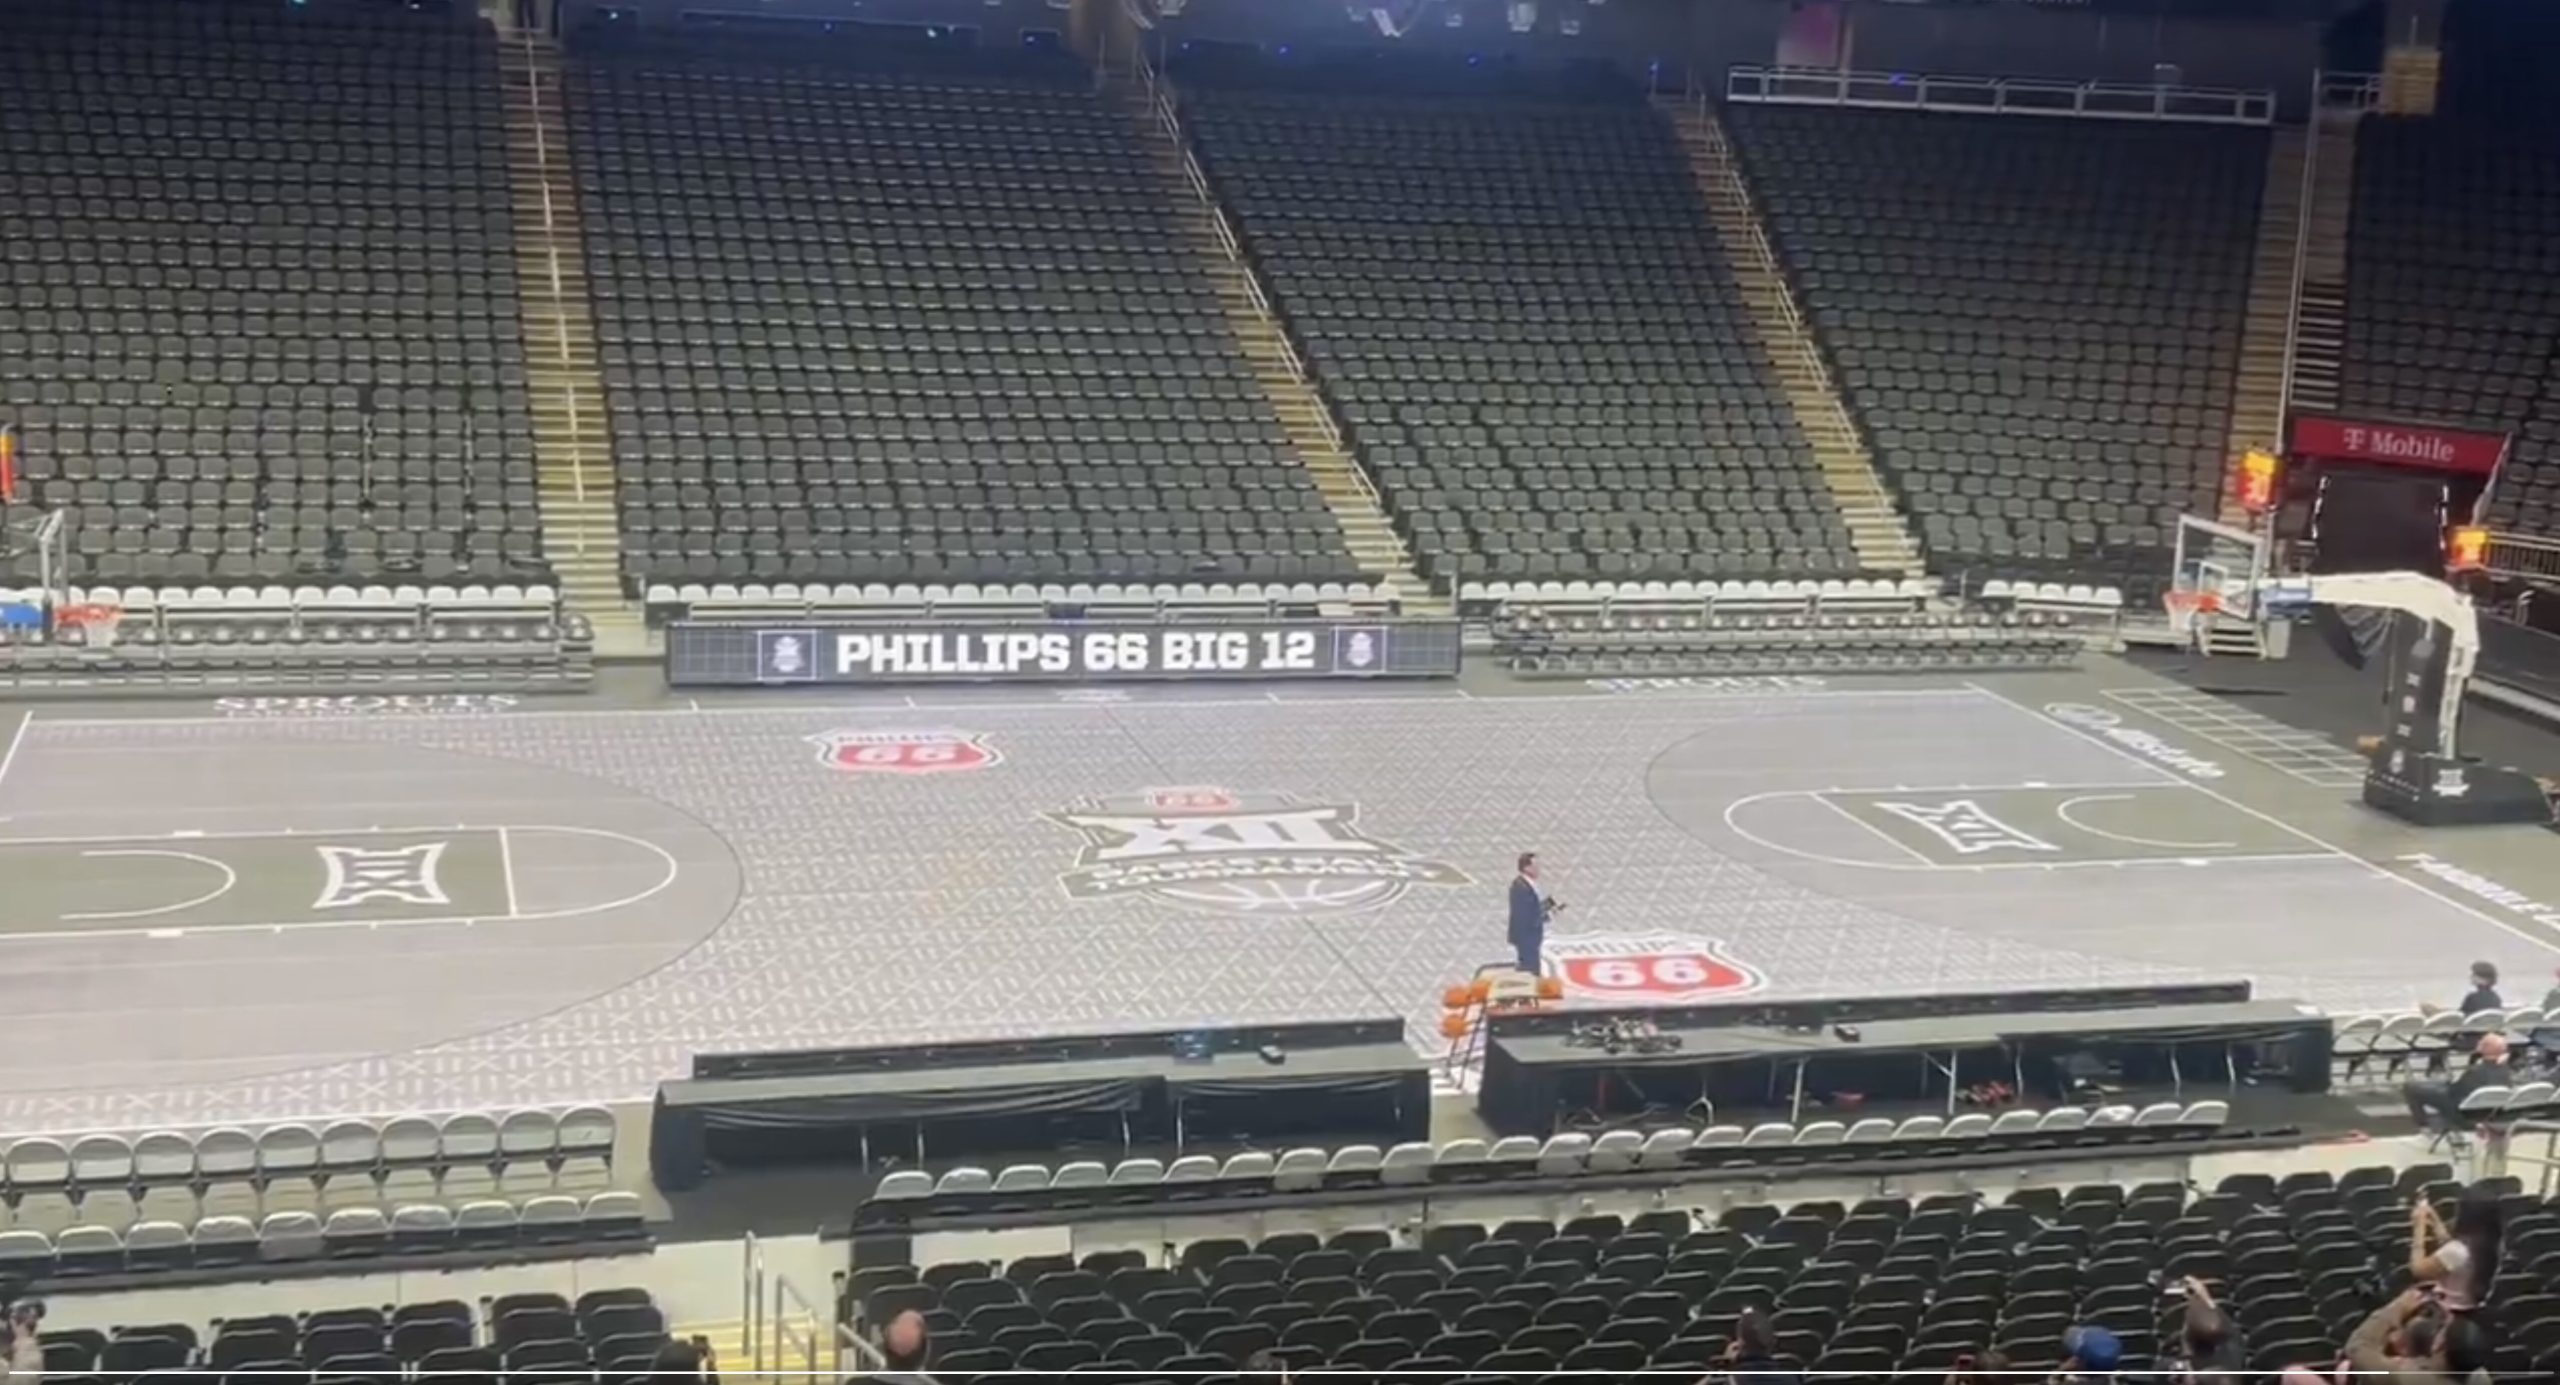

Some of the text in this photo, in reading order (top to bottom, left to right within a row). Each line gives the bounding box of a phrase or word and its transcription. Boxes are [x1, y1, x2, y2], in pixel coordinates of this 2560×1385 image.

[2370, 431, 2455, 462] Mobile
[836, 633, 1071, 674] PHILLIPS
[1083, 631, 1149, 671] 66
[1162, 631, 1248, 670] BIG
[1260, 630, 1315, 670] 12
[854, 745, 957, 763] 66
[1588, 956, 1709, 987] 66
